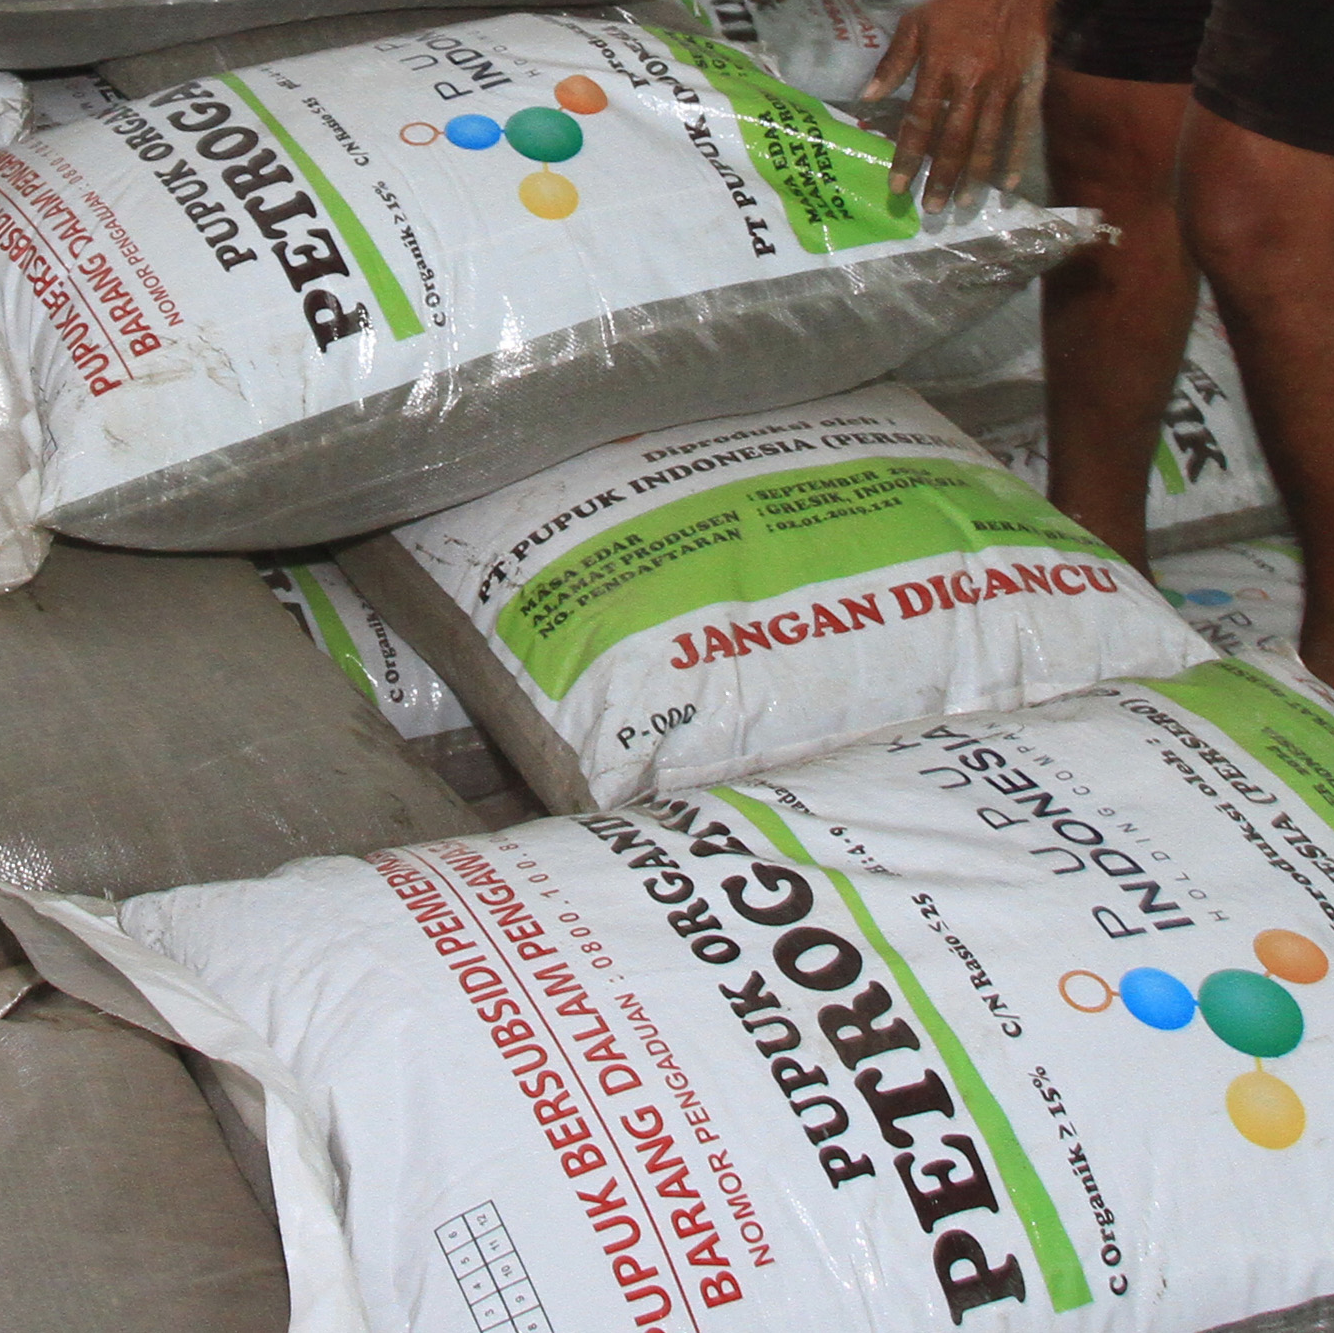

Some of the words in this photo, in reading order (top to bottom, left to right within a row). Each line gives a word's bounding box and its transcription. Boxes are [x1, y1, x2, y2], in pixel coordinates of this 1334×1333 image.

[148, 79, 371, 355] PETROGA
[153, 158, 259, 273] PUPUK
[683, 116, 759, 214] PUPUK
[29, 187, 94, 260] DALAM
[398, 223, 442, 309] Organik
[744, 216, 777, 259] PT
[77, 252, 163, 358] BARANG
[134, 263, 185, 328] NOMOR
[55, 303, 124, 398] PUPUK
[475, 558, 509, 606] PT
[510, 485, 628, 563] PUPUK
[627, 436, 814, 496] INDONESIA
[529, 560, 619, 629] ALAMAT
[618, 509, 742, 569] PRODUSEN
[574, 527, 744, 612] PENDAFTARAN
[519, 564, 585, 619] MASA
[579, 532, 647, 570] EDAR
[670, 591, 885, 670] JANGAN
[888, 562, 1118, 620] DIGANCU
[616, 703, 698, 751] P-000
[1117, 697, 1278, 806] (PERSERO)
[1160, 748, 1219, 798] oleh
[920, 722, 1196, 932] INDONESIA
[1097, 806, 1231, 923] HOLDING
[944, 935, 992, 992] Rasio
[981, 992, 1023, 1038] C/N
[450, 954, 608, 1179] BERSUBSIDI
[533, 961, 644, 1098] DALAM
[612, 991, 722, 1146] PENGADUAN
[718, 969, 877, 1190] PUPUK
[1028, 1065, 1067, 1118] 15%
[576, 1175, 679, 1333] UPUK
[620, 1103, 744, 1310] BARANG
[706, 1147, 776, 1269] NOMOR
[1067, 1141, 1123, 1268] Organik
[1109, 1273, 1128, 1296] C
